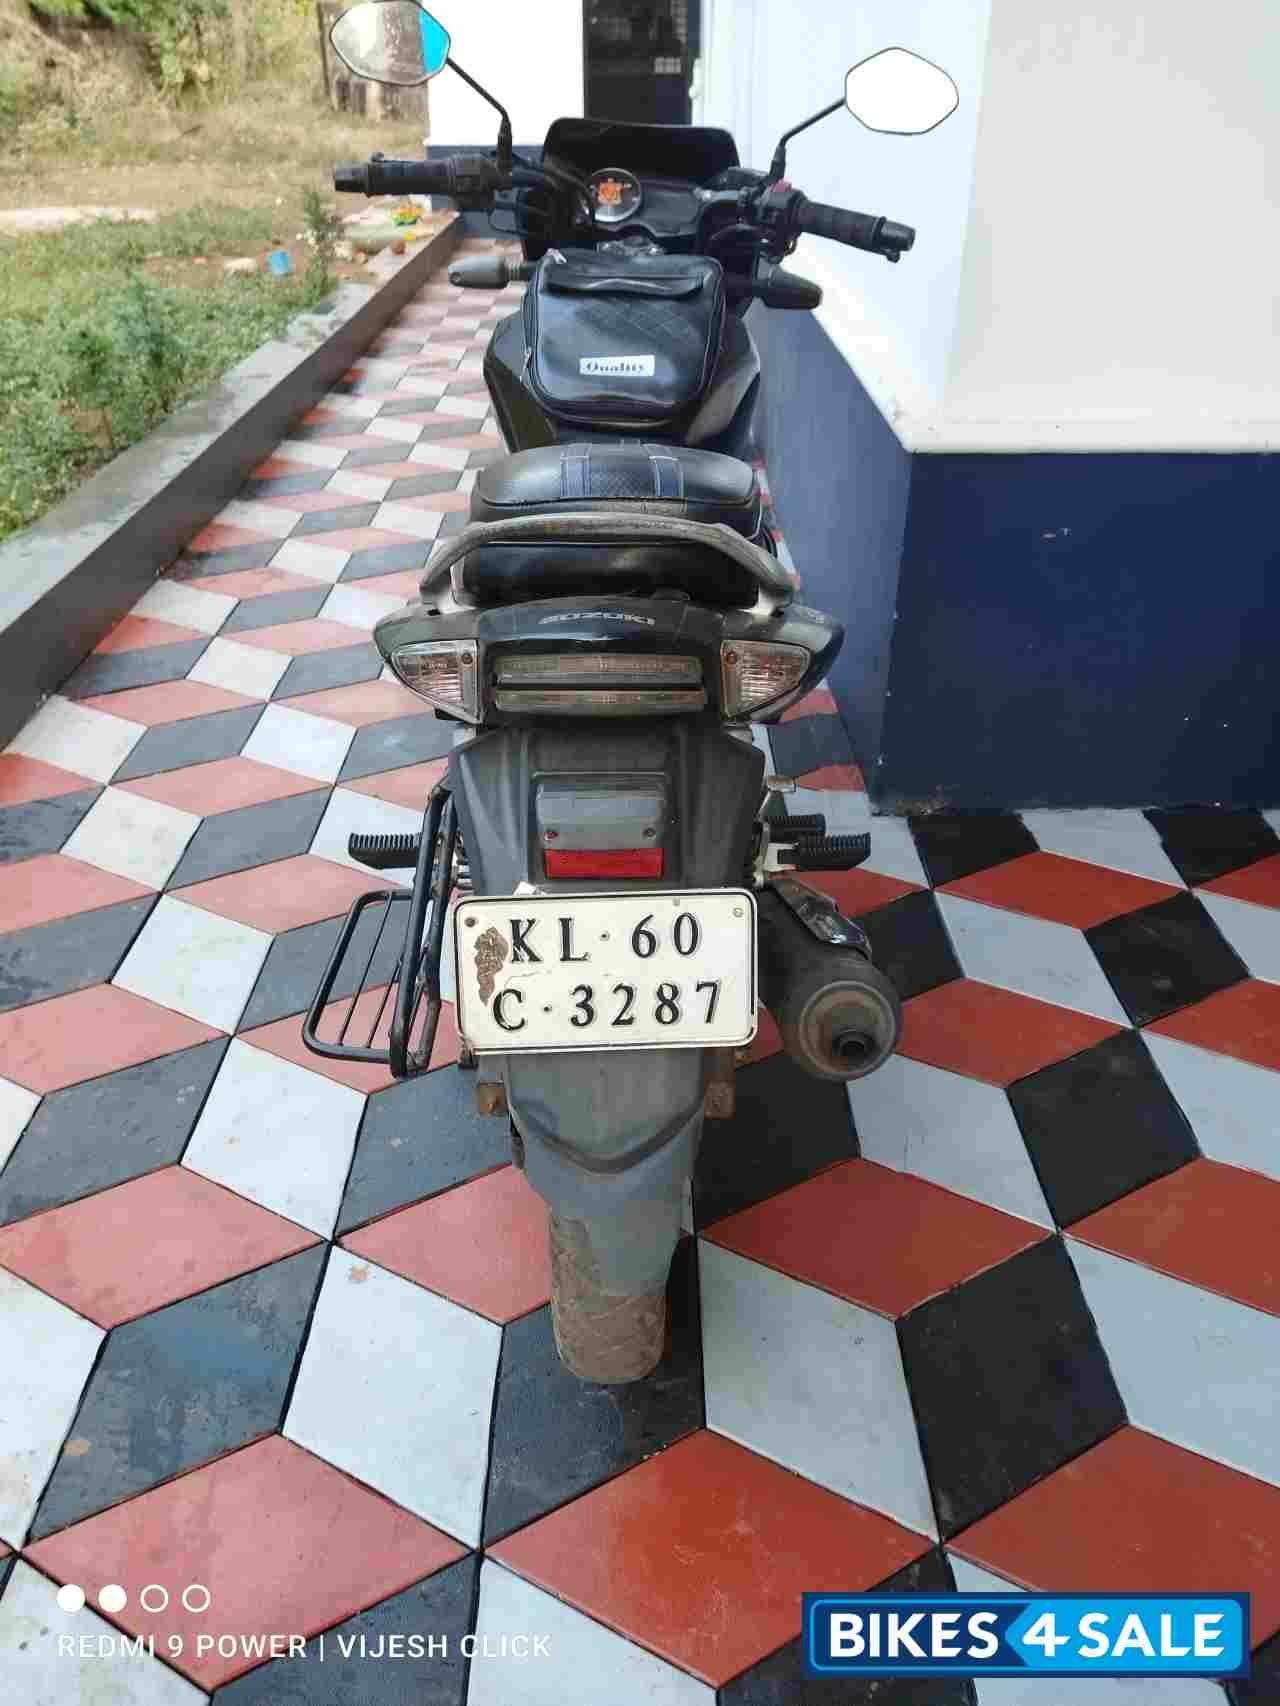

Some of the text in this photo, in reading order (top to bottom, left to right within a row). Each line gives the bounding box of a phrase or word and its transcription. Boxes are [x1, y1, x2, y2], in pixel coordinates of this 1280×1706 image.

[538, 611, 656, 626] SUZUKI
[631, 911, 699, 959] 60
[569, 979, 720, 1027] 3287
